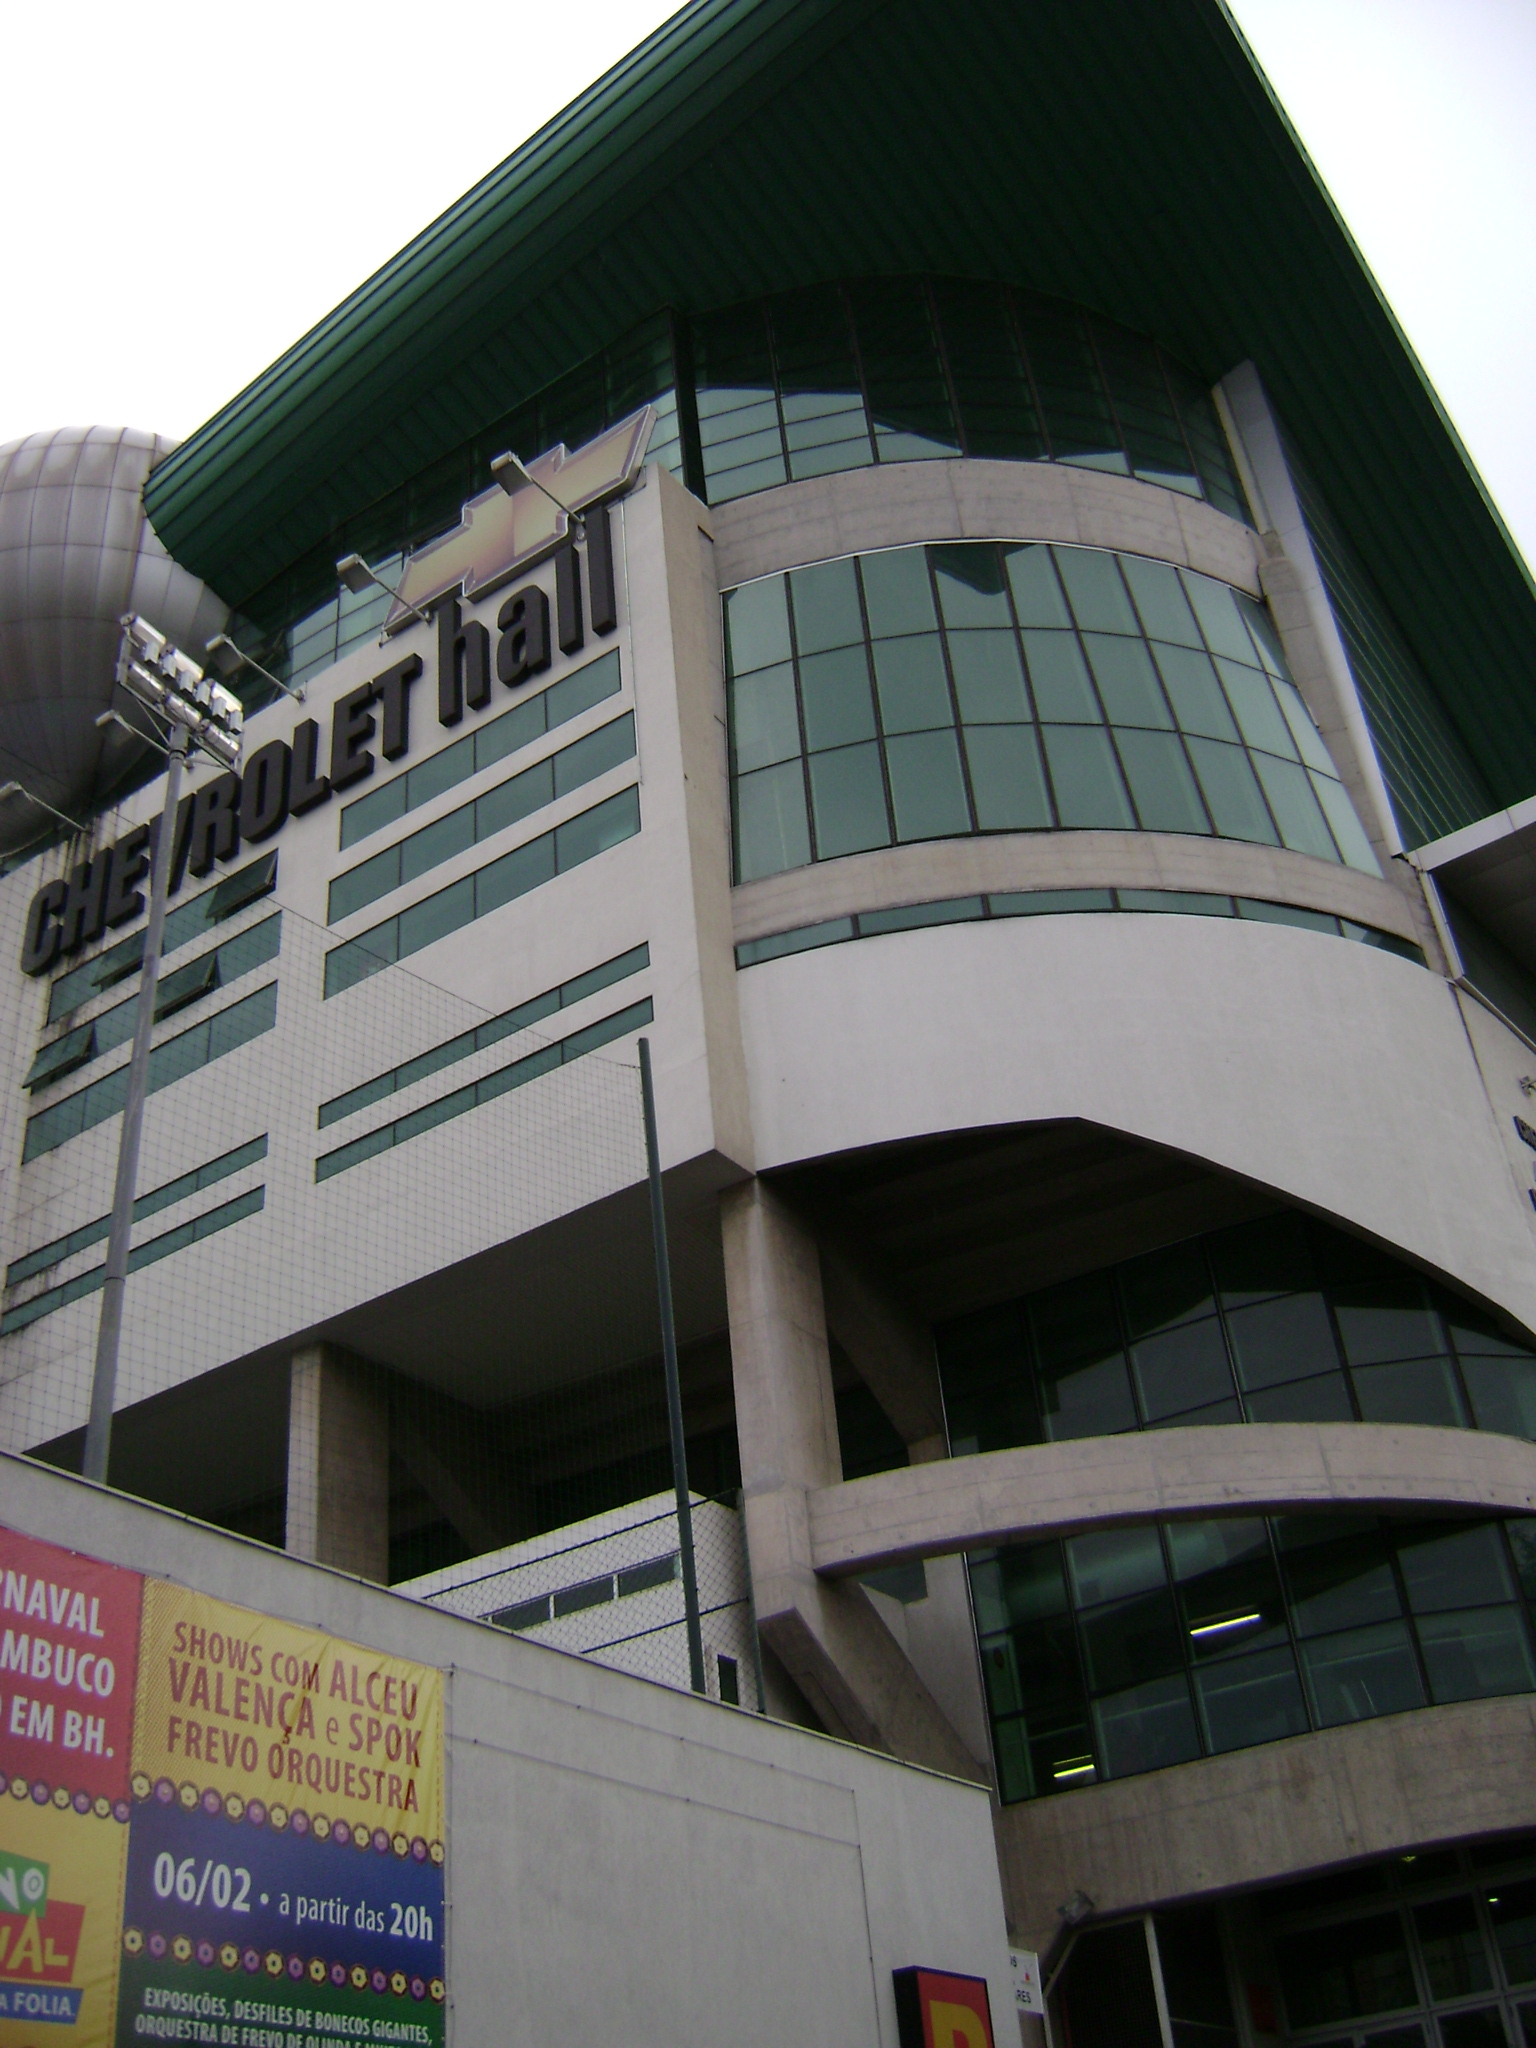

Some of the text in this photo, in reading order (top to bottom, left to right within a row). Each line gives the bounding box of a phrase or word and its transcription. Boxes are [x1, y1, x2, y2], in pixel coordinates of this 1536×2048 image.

[20, 504, 617, 978] CHEVROLET hall
[0, 1568, 105, 1638] NAVAL
[168, 1656, 422, 1769] VALENÇA e SPOK
[173, 1621, 418, 1722] SHOWS COM ALCEU
[10, 1695, 115, 1758] EM BH.
[167, 1715, 419, 1814] FREVO ORQUESTRA
[153, 1851, 434, 1942] 06/02 a partir das 20h
[135, 2013, 219, 2043] ORQUESTRA
[221, 2024, 239, 2046] DE
[241, 2027, 284, 2048] FREVO
[144, 1987, 433, 2046] EXPOSIÇÕES, DESFILES DE BONECOS GIGANTES,
